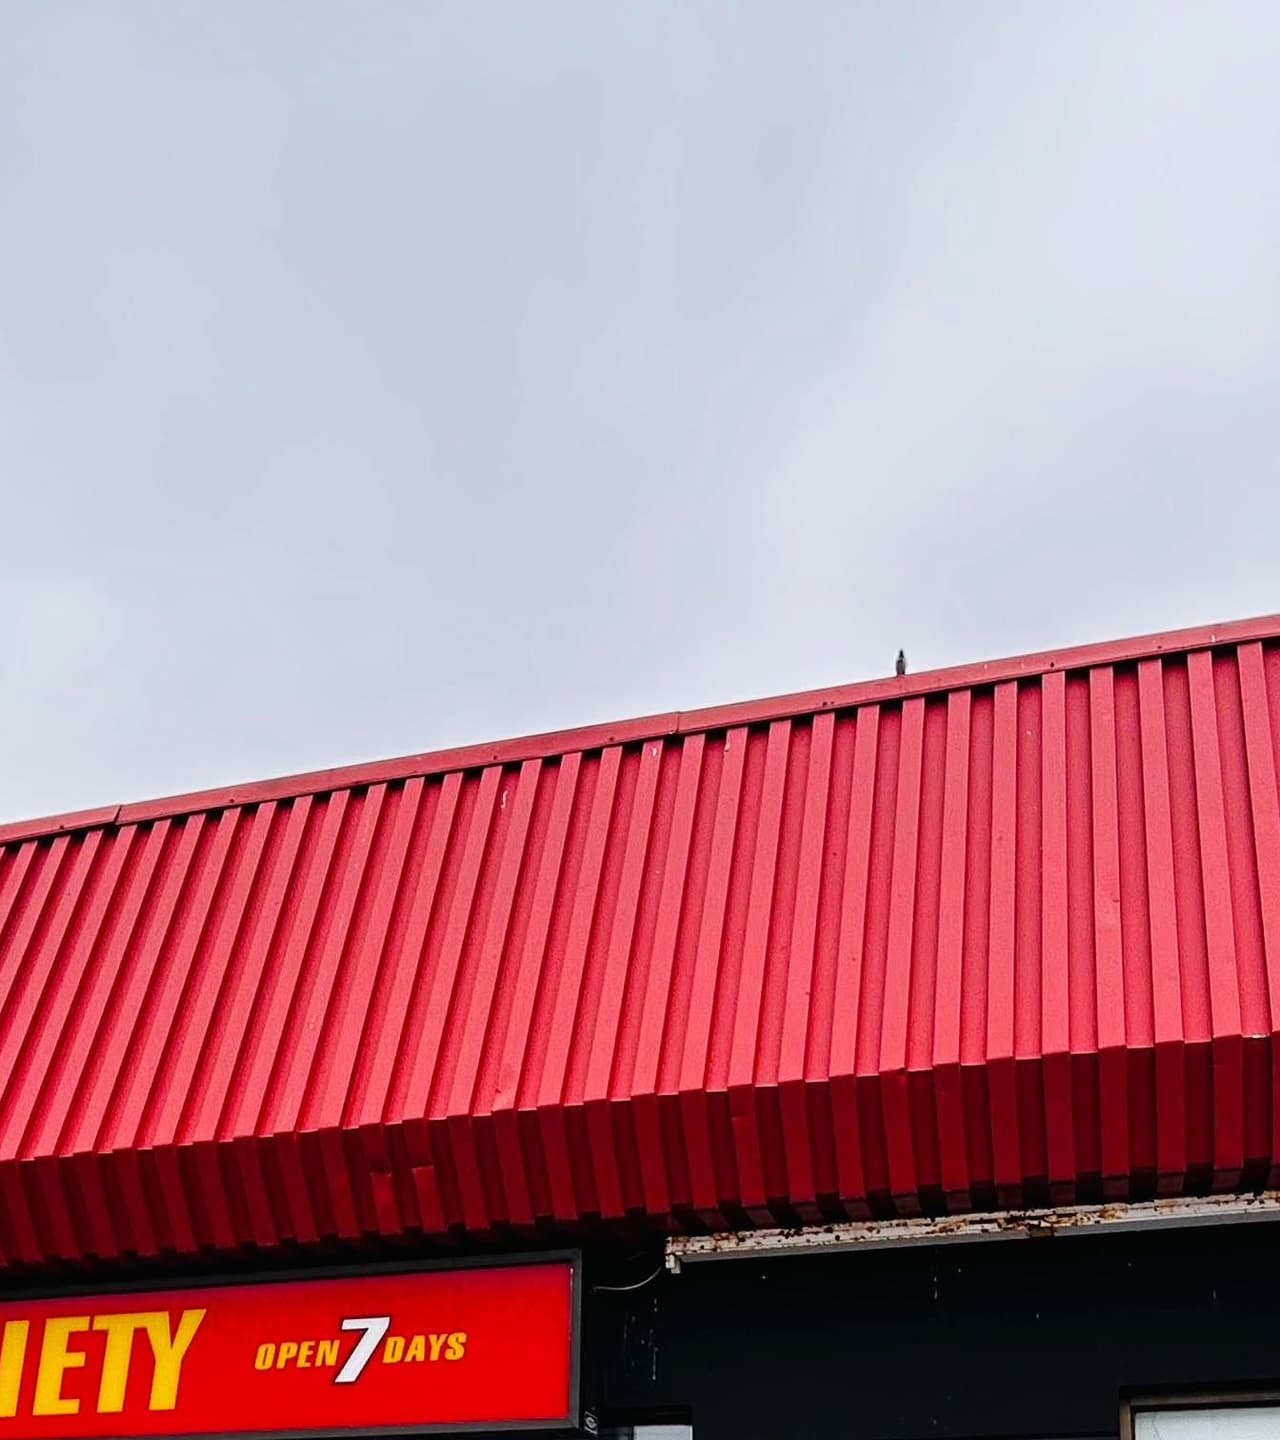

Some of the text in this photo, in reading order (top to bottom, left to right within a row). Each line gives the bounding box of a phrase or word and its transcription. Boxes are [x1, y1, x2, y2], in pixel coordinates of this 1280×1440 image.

[254, 1316, 468, 1384] OPEN 7 DAYS
